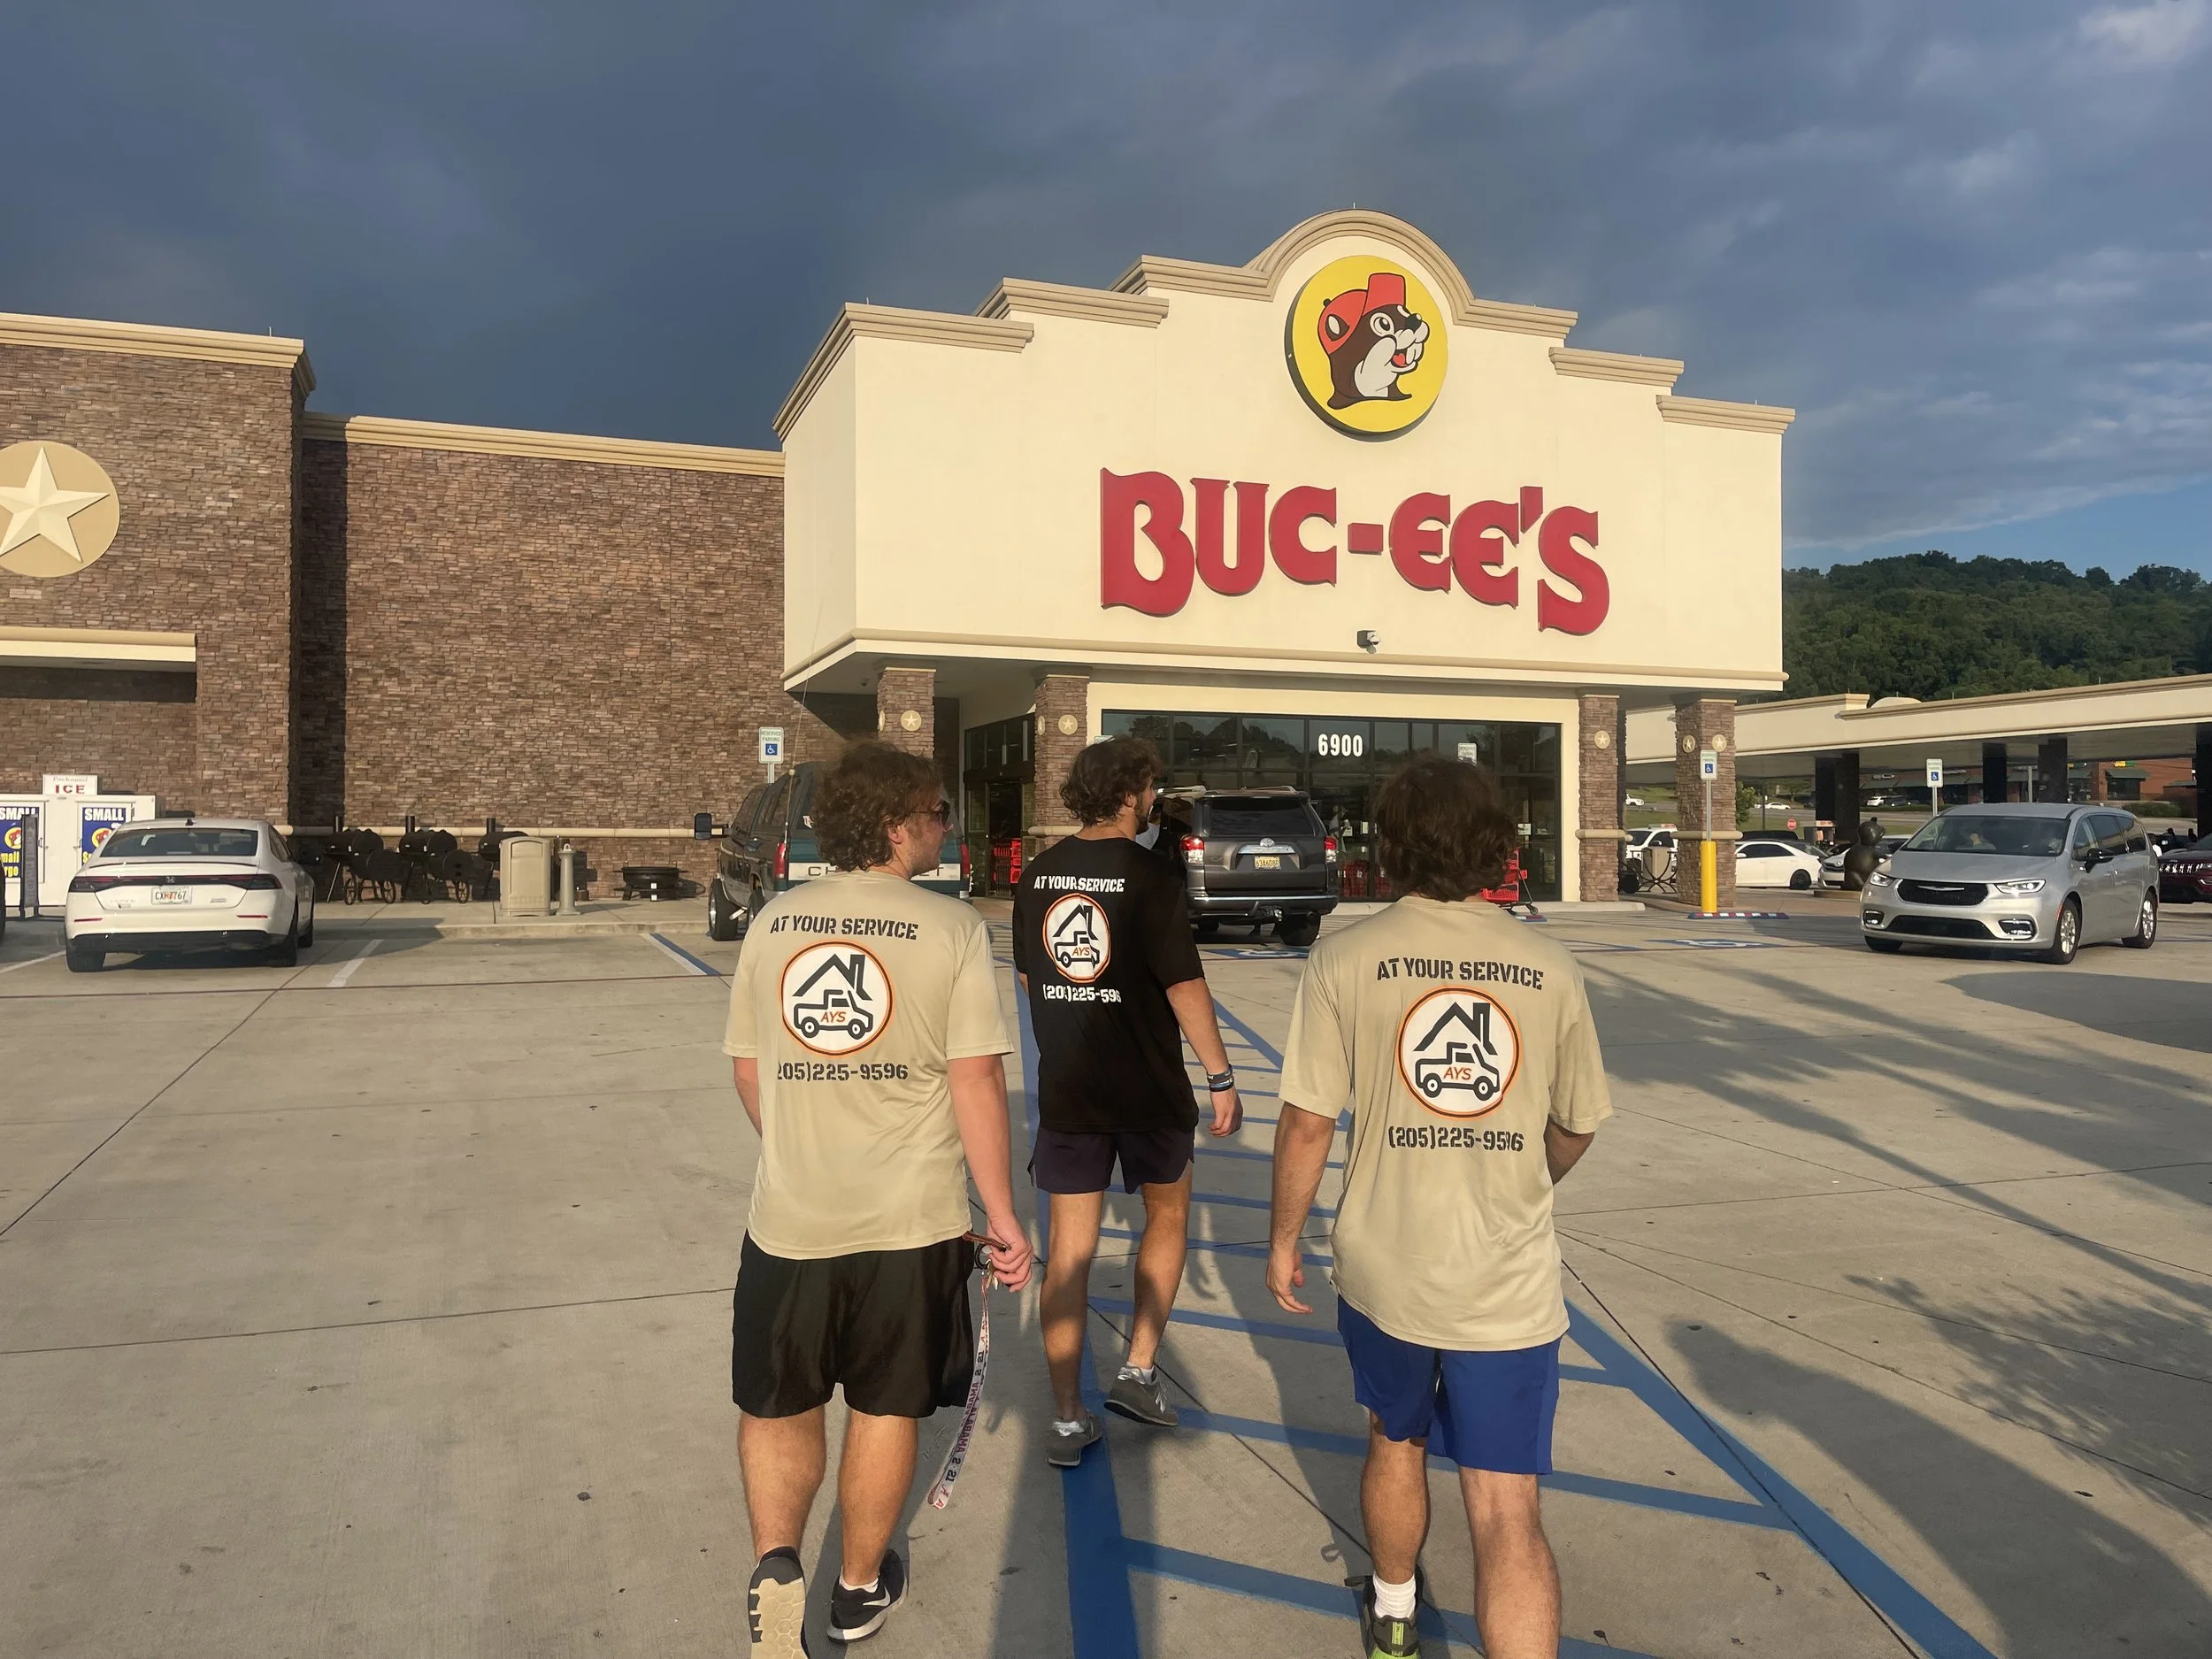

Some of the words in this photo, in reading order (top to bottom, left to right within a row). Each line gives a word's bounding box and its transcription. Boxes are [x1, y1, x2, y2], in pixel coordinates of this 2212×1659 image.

[1317, 733, 1363, 757] 6900
[55, 785, 85, 795] ICE
[84, 807, 124, 821] SMALL
[1033, 875, 1047, 889] AT
[1048, 876, 1078, 890] YOUR
[1078, 877, 1125, 893] SERVICE
[770, 915, 789, 933] AT
[793, 915, 837, 934] YOUR
[841, 918, 919, 941] SERVICE
[1071, 947, 1090, 956] AYS
[1377, 957, 1400, 980] AT
[1402, 956, 1454, 980] YOUR
[1459, 961, 1544, 991] SERVICE
[820, 1011, 847, 1023] AYS
[1443, 1066, 1472, 1080] AYS
